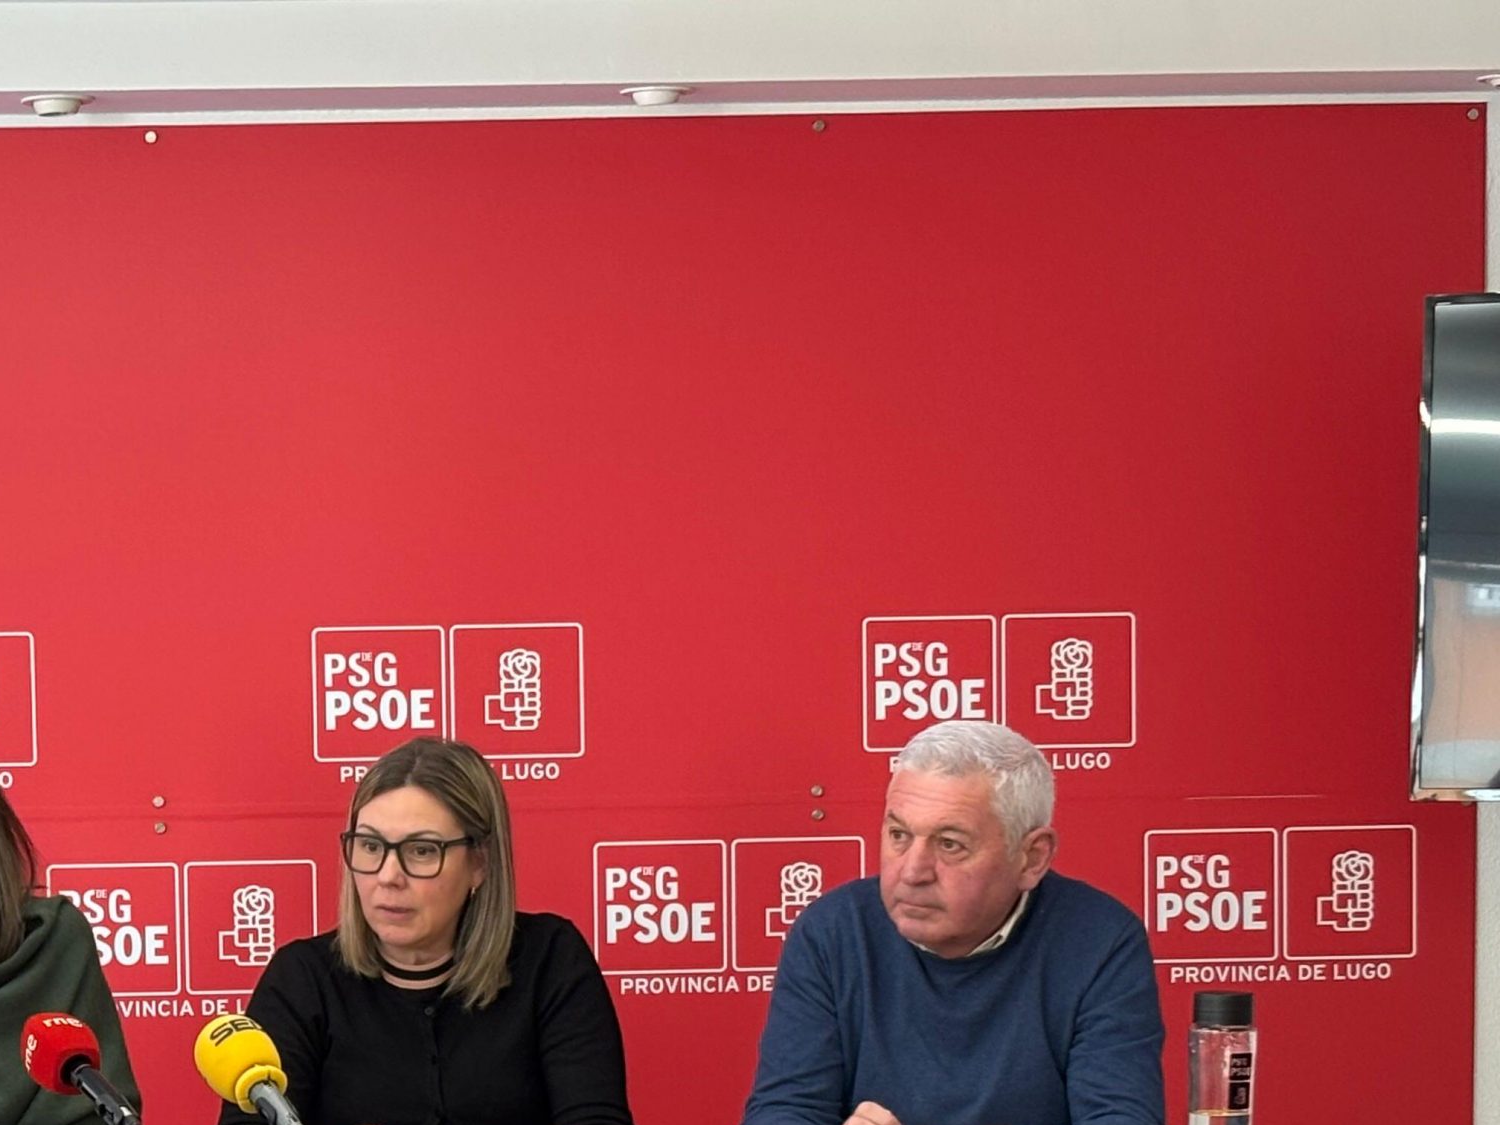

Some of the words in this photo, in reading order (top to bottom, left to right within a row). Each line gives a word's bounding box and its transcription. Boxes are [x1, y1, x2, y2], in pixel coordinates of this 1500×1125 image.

[325, 689, 435, 730] PSOE
[874, 678, 986, 720] PSOE
[501, 762, 560, 780] LUGO
[1052, 752, 1111, 770] LUGO
[606, 902, 716, 944] PSOE
[1156, 890, 1268, 932] PSOE
[91, 925, 169, 966] SOE
[619, 975, 740, 995] PROVINCIA
[746, 974, 775, 992] DE
[1170, 965, 1291, 984] PROVINCIA
[1297, 963, 1327, 981] DE
[1332, 962, 1392, 980] LUGO
[116, 999, 195, 1018] VINCIA
[201, 998, 229, 1016] DE
